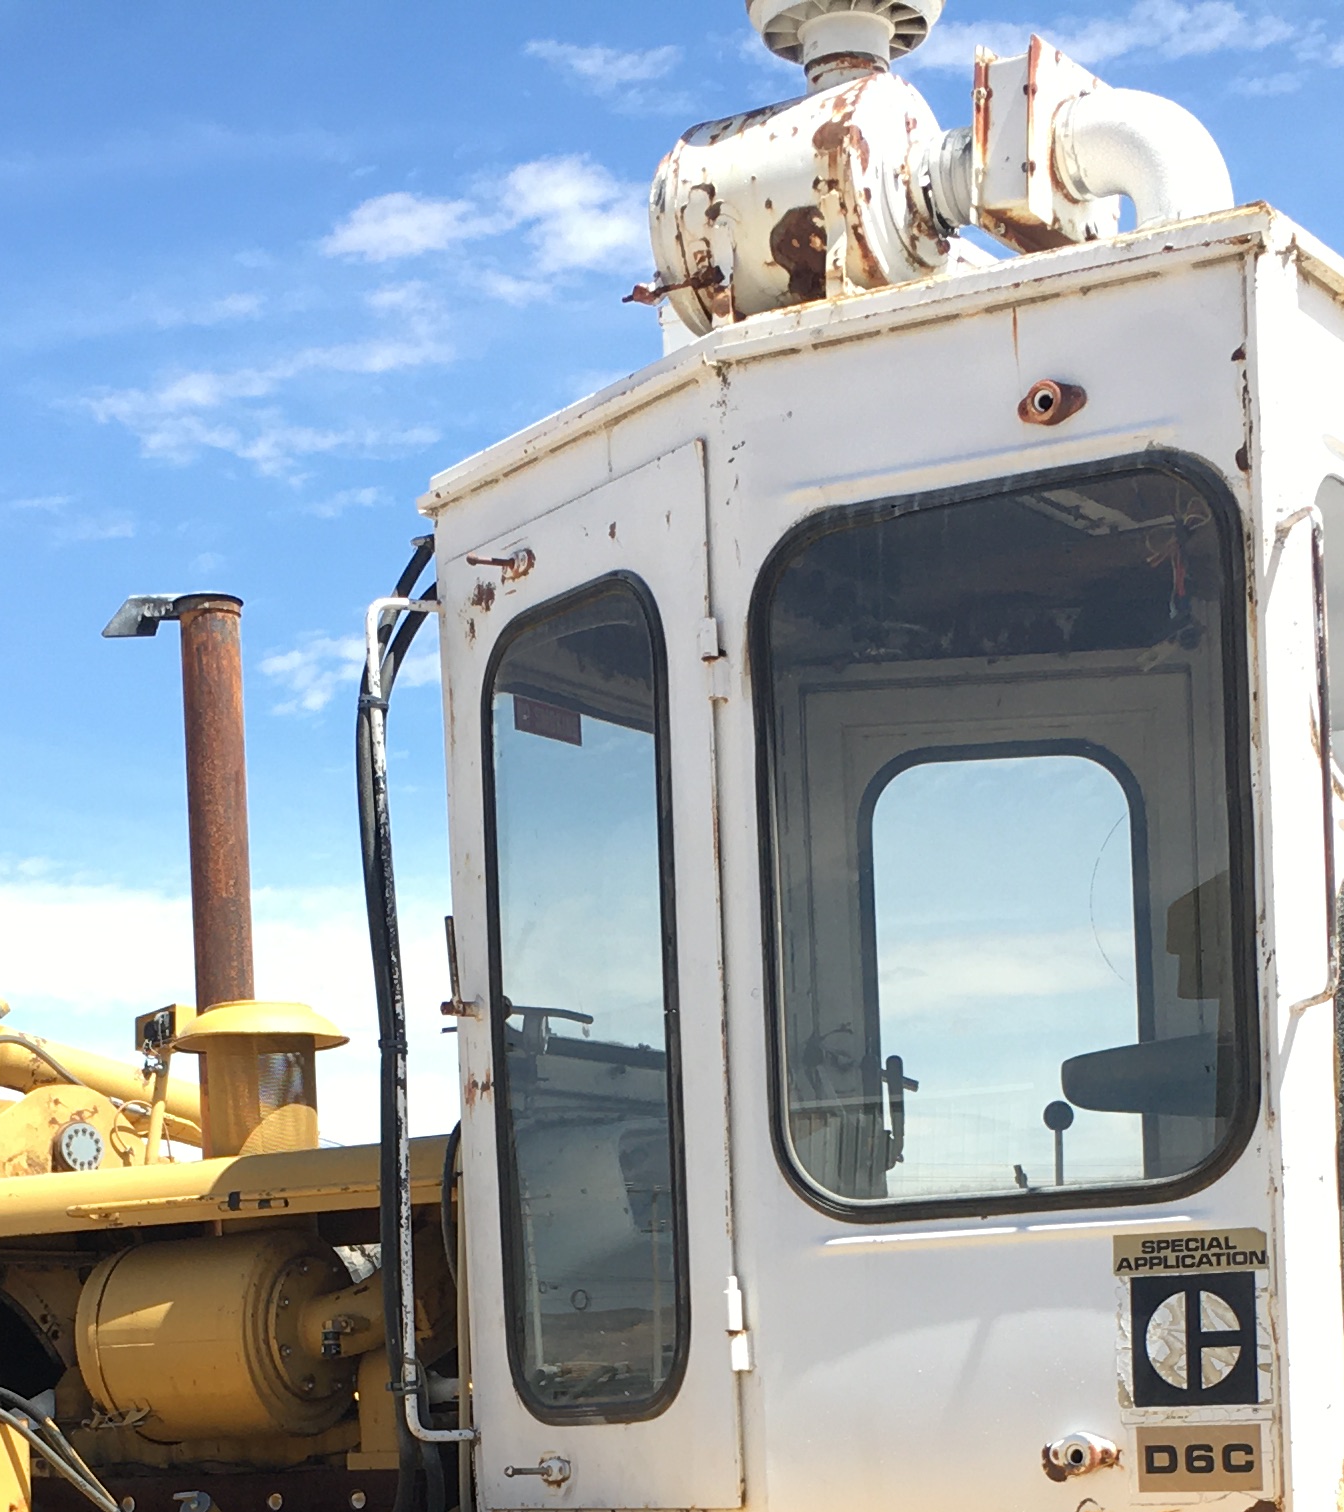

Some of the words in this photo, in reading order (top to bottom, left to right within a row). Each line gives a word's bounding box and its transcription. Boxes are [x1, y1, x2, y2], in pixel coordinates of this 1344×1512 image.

[1141, 1235, 1238, 1255] SPECIAL
[1115, 1249, 1267, 1272] APPLICATION
[1144, 1443, 1256, 1475] D6C
